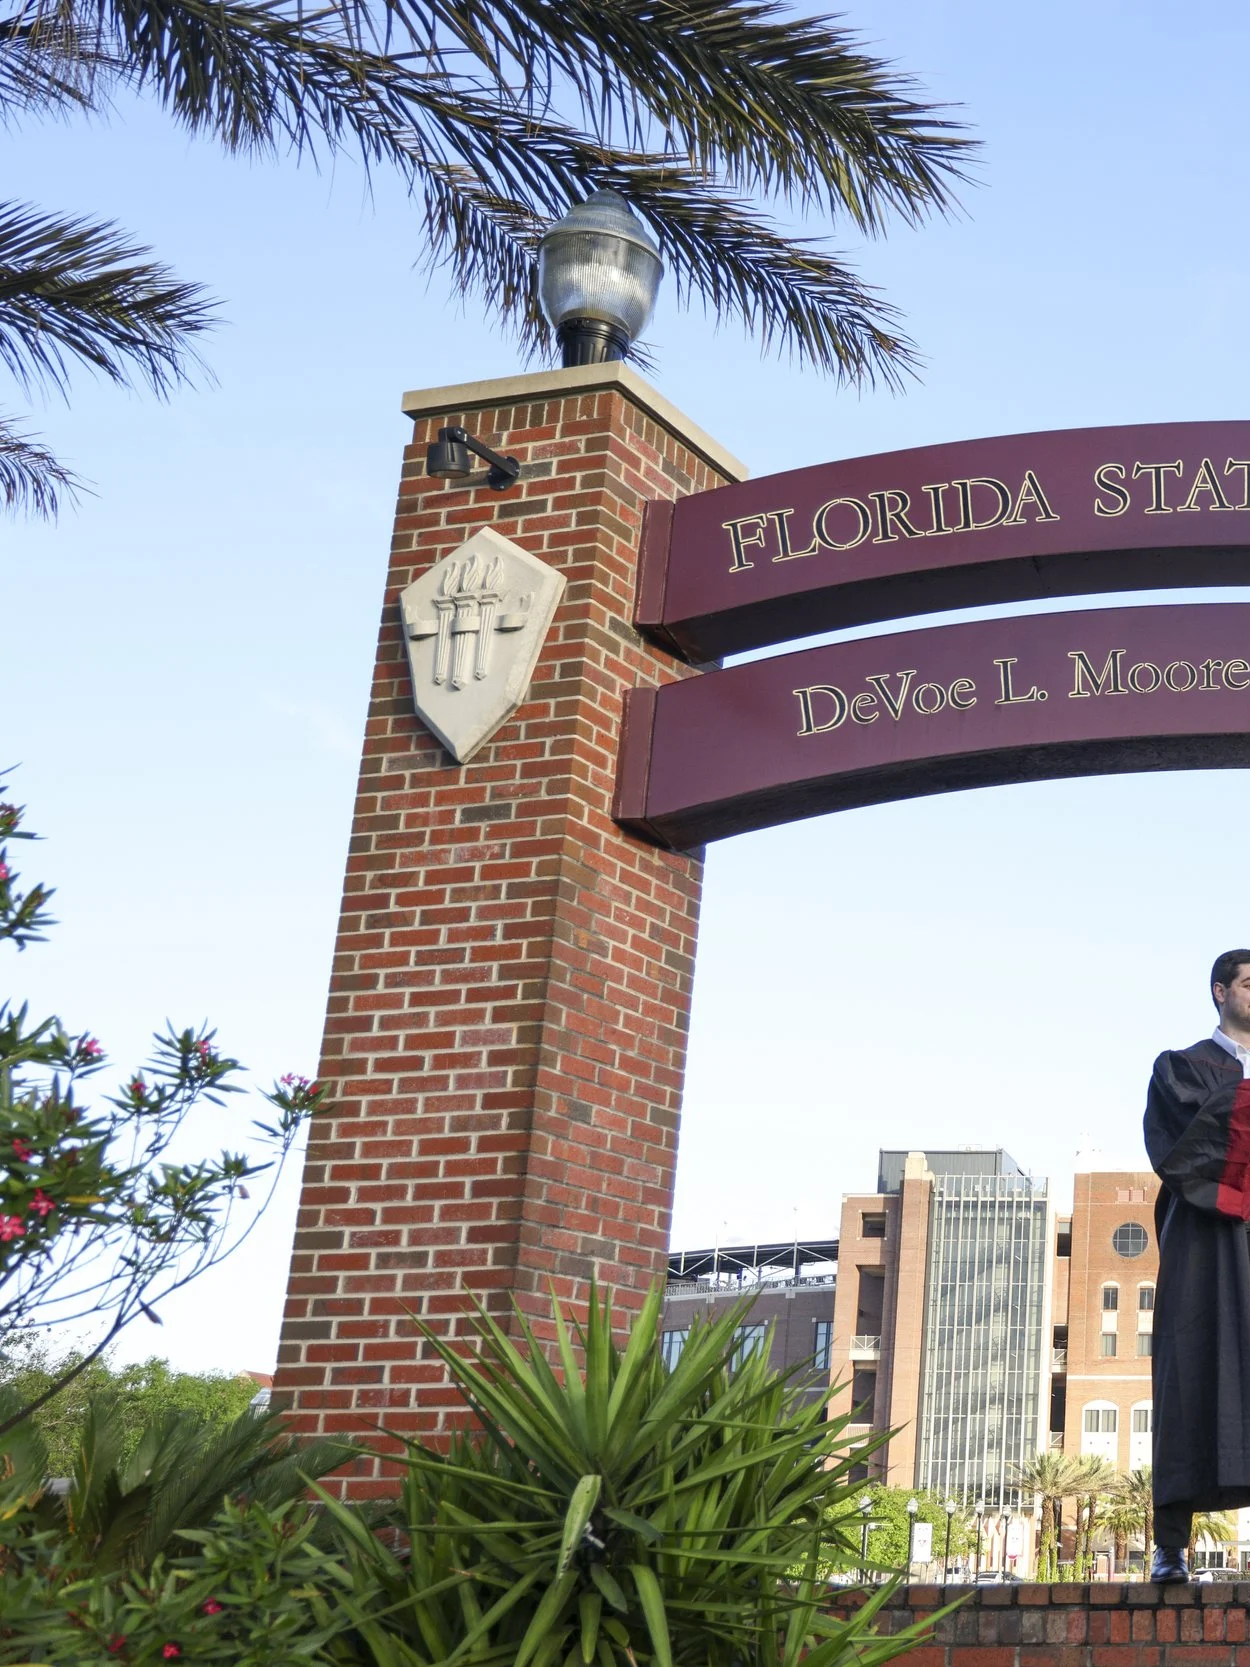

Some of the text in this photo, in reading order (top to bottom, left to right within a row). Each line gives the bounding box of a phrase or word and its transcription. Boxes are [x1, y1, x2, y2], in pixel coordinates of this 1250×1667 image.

[722, 470, 1060, 573] FLORIDA
[793, 670, 977, 736] DeVoe
[994, 657, 1048, 705] L.
[1068, 648, 1250, 699] Moore
